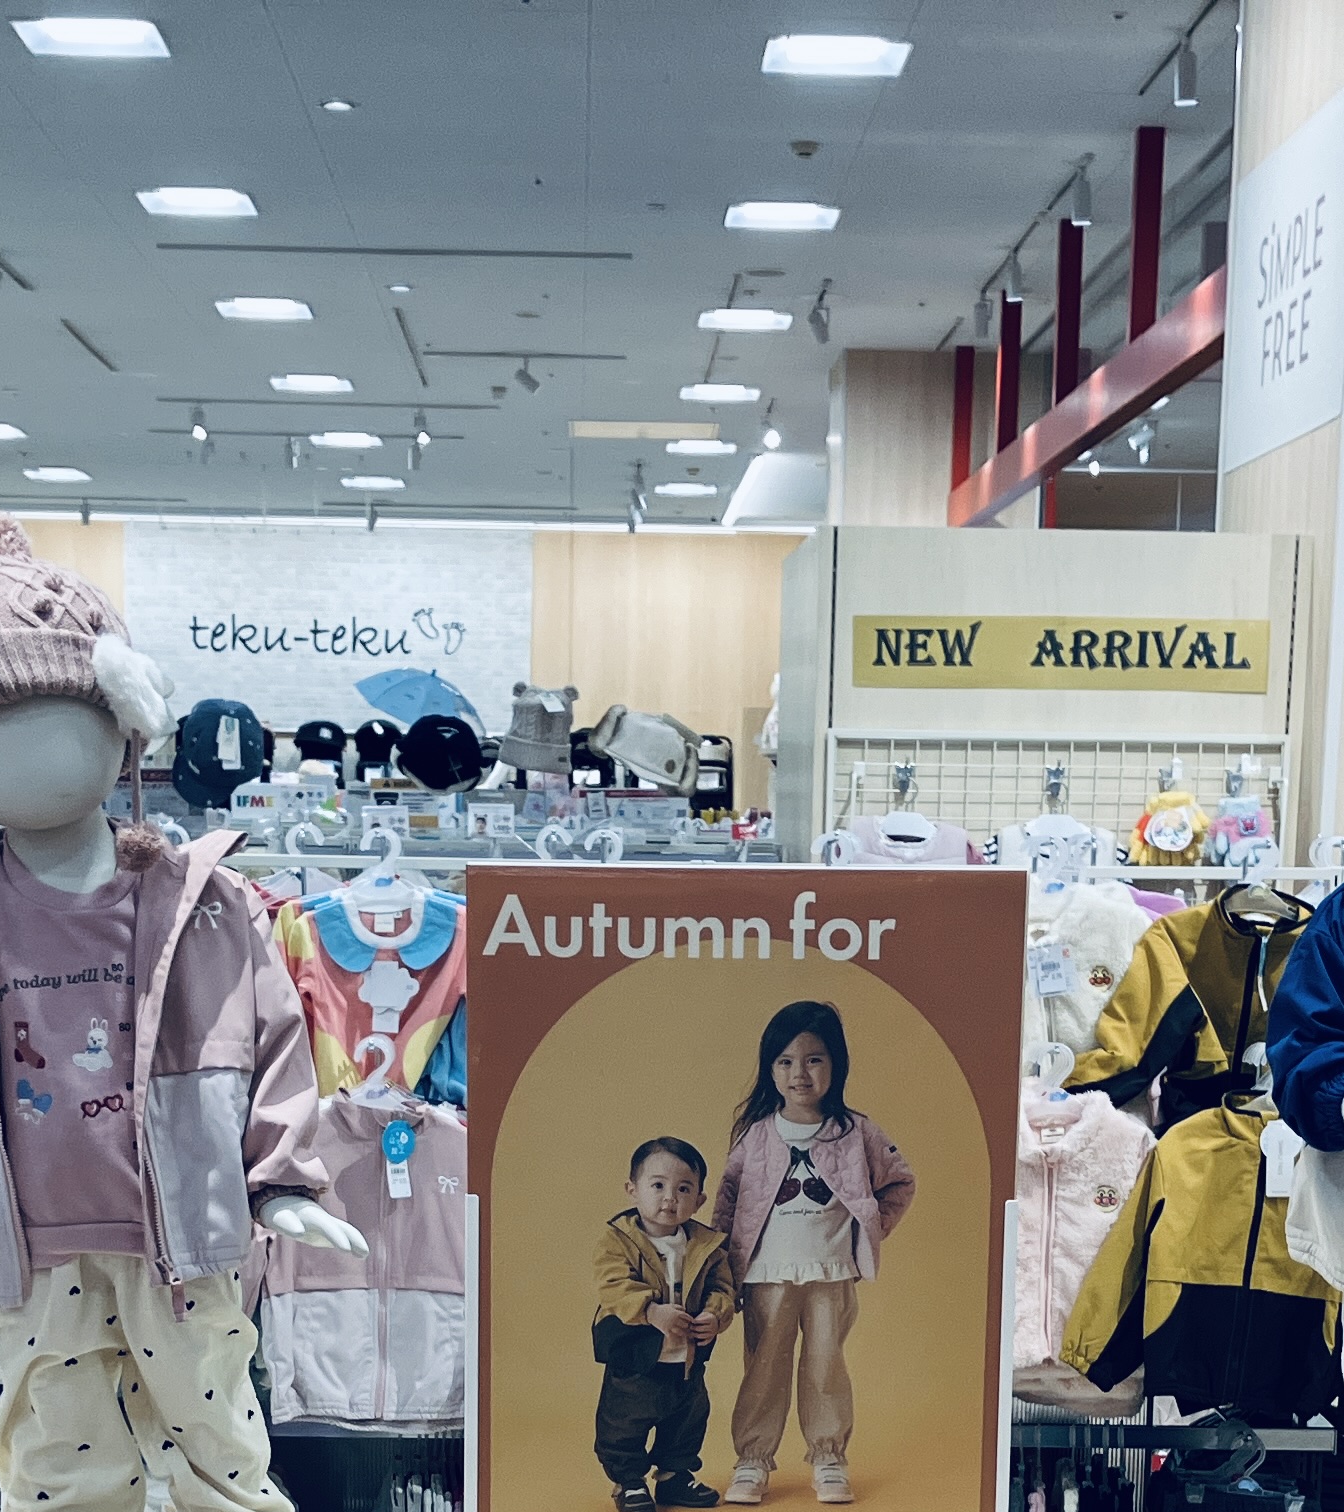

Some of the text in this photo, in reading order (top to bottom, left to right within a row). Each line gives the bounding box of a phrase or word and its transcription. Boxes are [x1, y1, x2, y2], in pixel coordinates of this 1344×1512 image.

[1261, 290, 1311, 386] FREE
[189, 613, 411, 656] teku-teku
[872, 620, 1251, 671] NEW ARRIVAL
[482, 891, 897, 961] Autumn for
[13, 975, 62, 990] today
[66, 968, 99, 985] will
[103, 968, 122, 983] be
